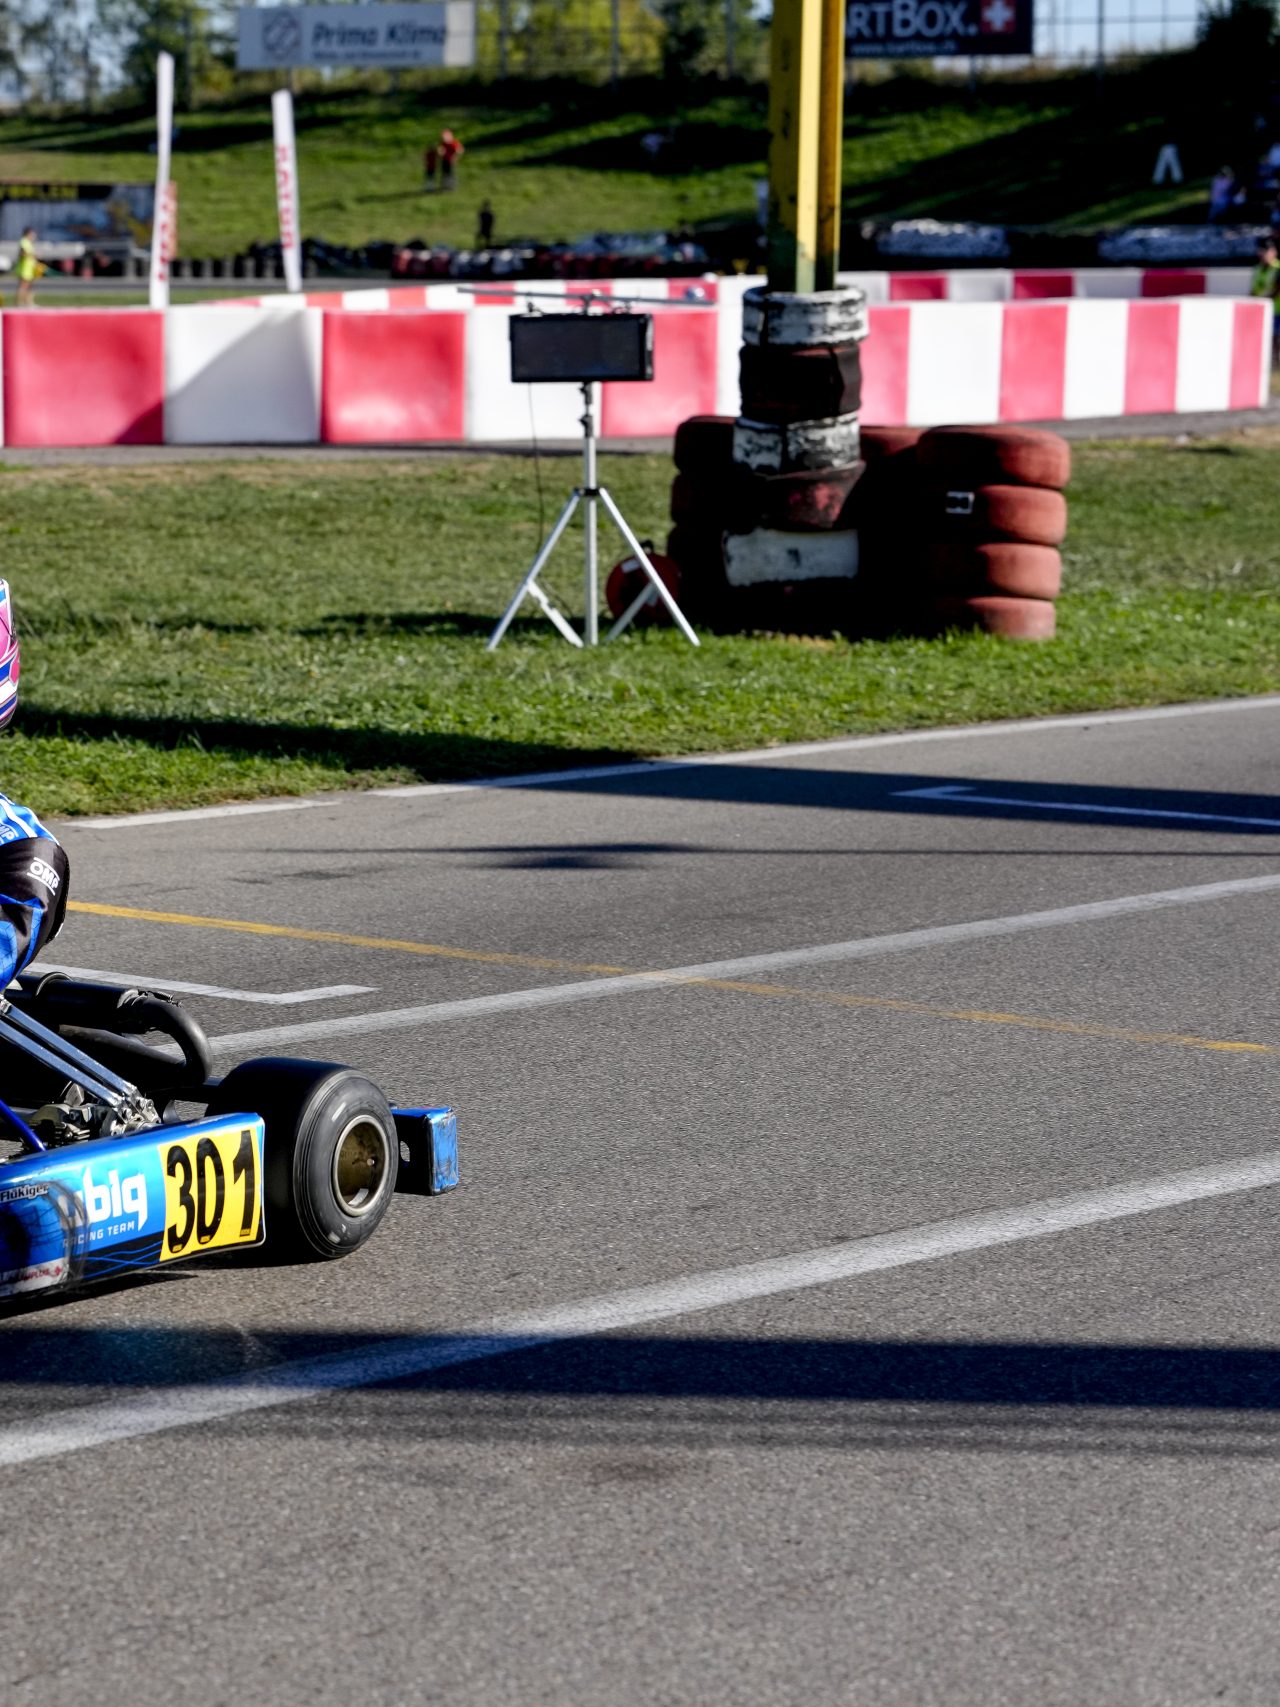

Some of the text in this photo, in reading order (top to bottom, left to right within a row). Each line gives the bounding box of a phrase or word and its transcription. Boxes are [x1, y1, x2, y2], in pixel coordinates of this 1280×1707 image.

[29, 860, 60, 890] OMP
[166, 1129, 256, 1254] 301
[107, 1220, 135, 1237] TEAM
